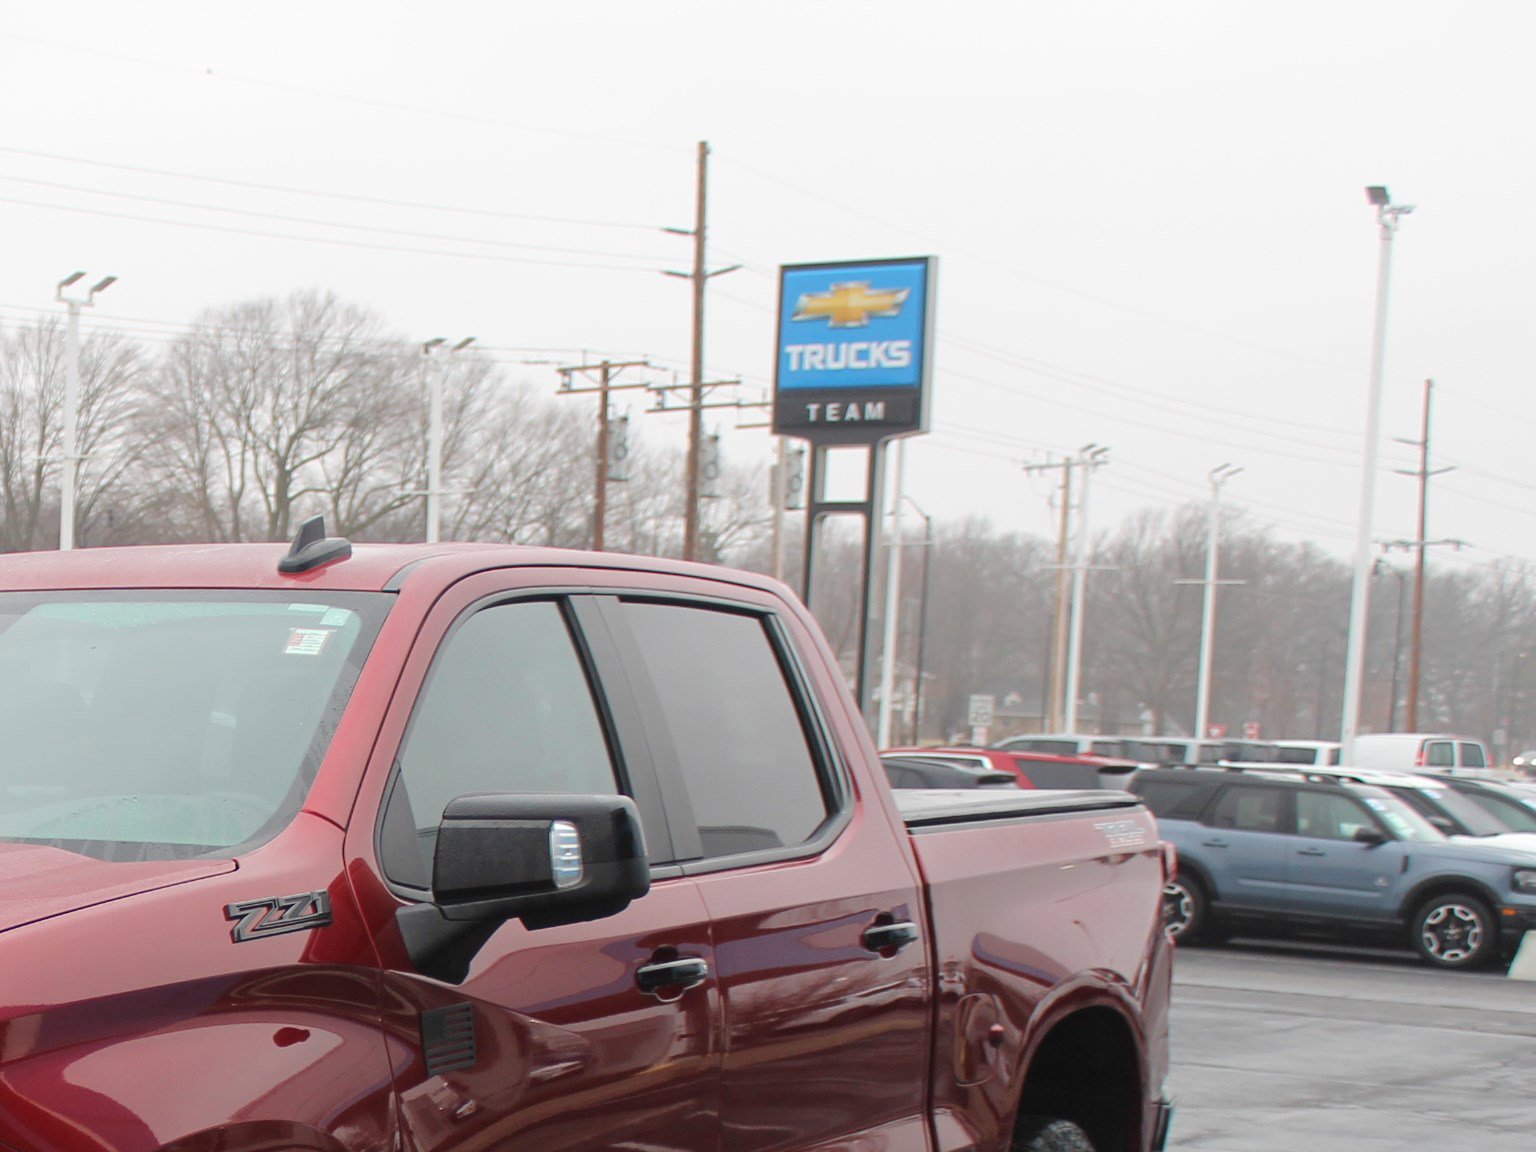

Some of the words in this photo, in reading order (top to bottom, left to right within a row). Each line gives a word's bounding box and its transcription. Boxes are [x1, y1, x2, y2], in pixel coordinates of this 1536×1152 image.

[784, 340, 913, 372] TRUCKS
[806, 401, 886, 422] TEAM
[223, 889, 333, 944] Z71
